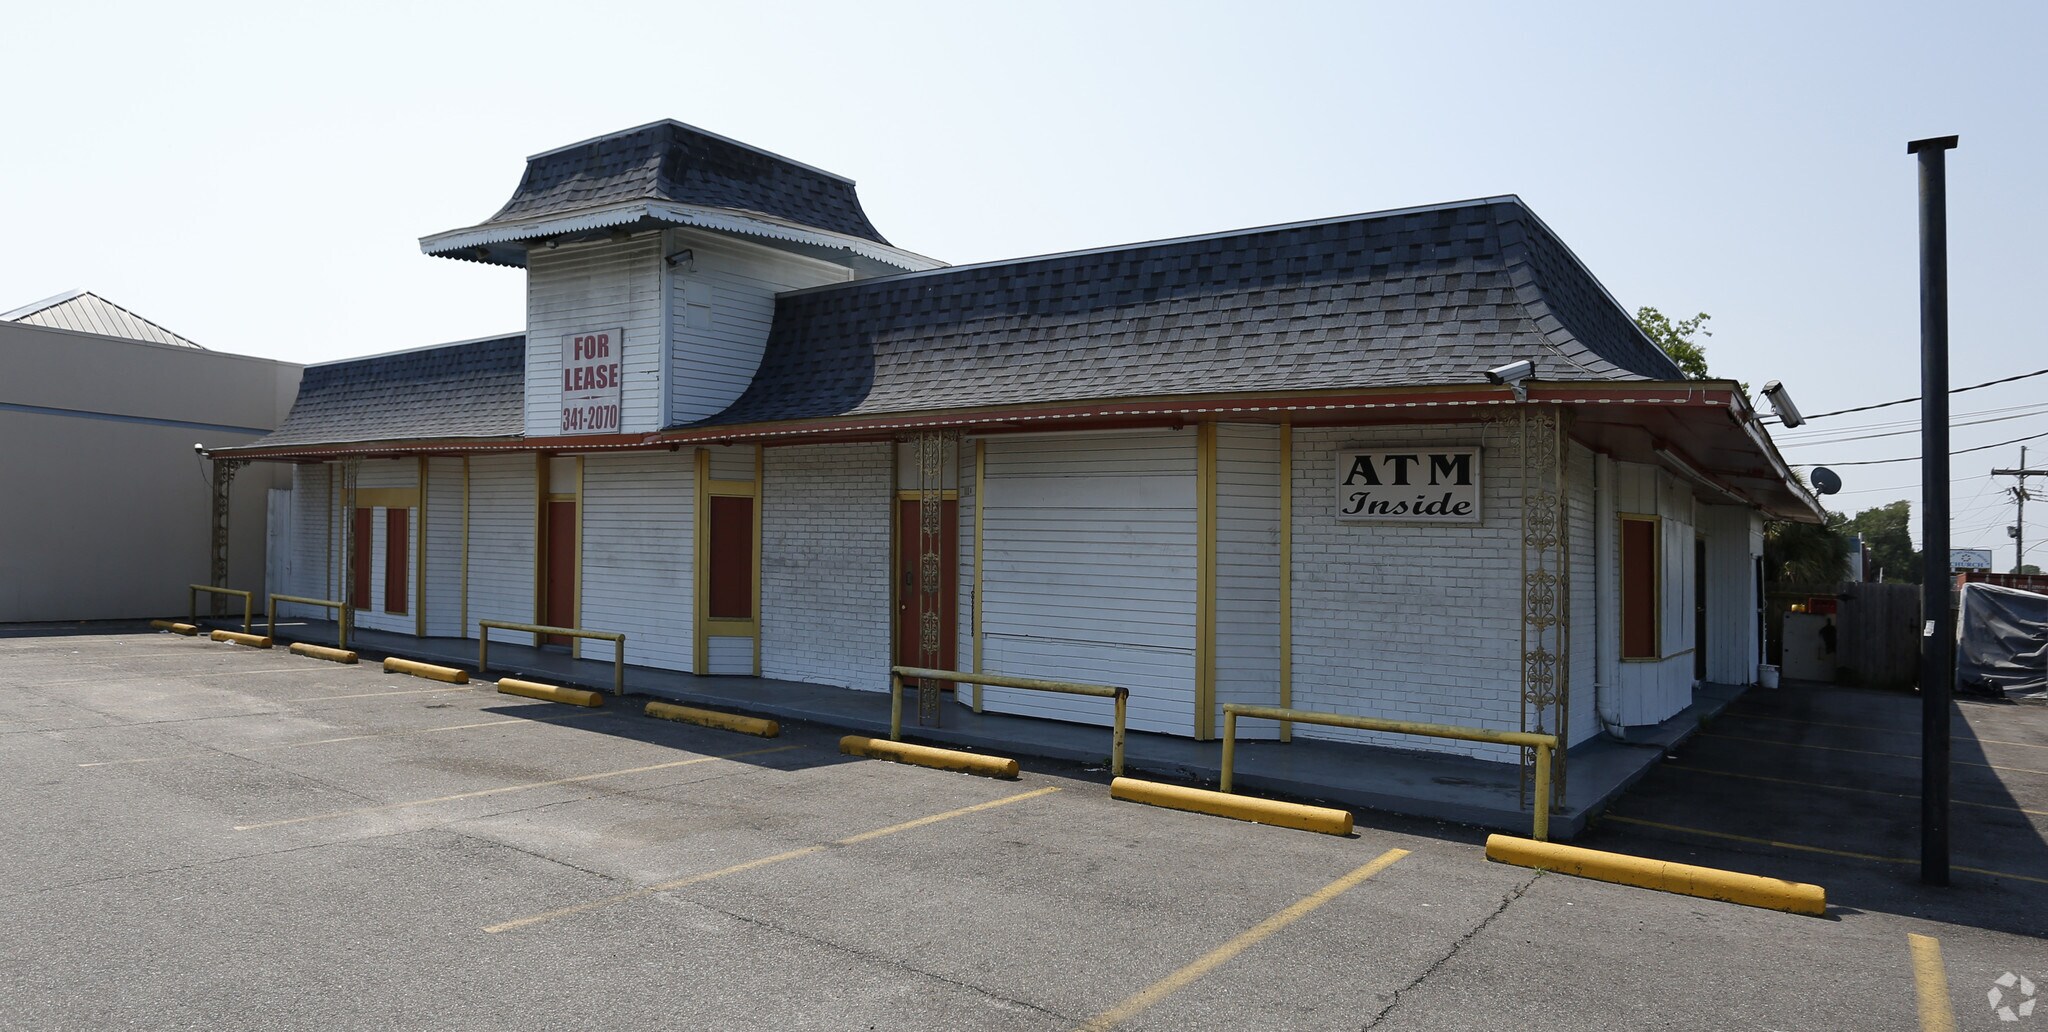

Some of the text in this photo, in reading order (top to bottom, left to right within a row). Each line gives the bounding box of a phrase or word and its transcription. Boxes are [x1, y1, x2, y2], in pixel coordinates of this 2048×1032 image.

[574, 334, 609, 360] FOR
[564, 364, 618, 391] LEASE
[563, 404, 618, 431] 341-2070
[1342, 454, 1473, 486] ATM
[1342, 491, 1473, 516] Inside
